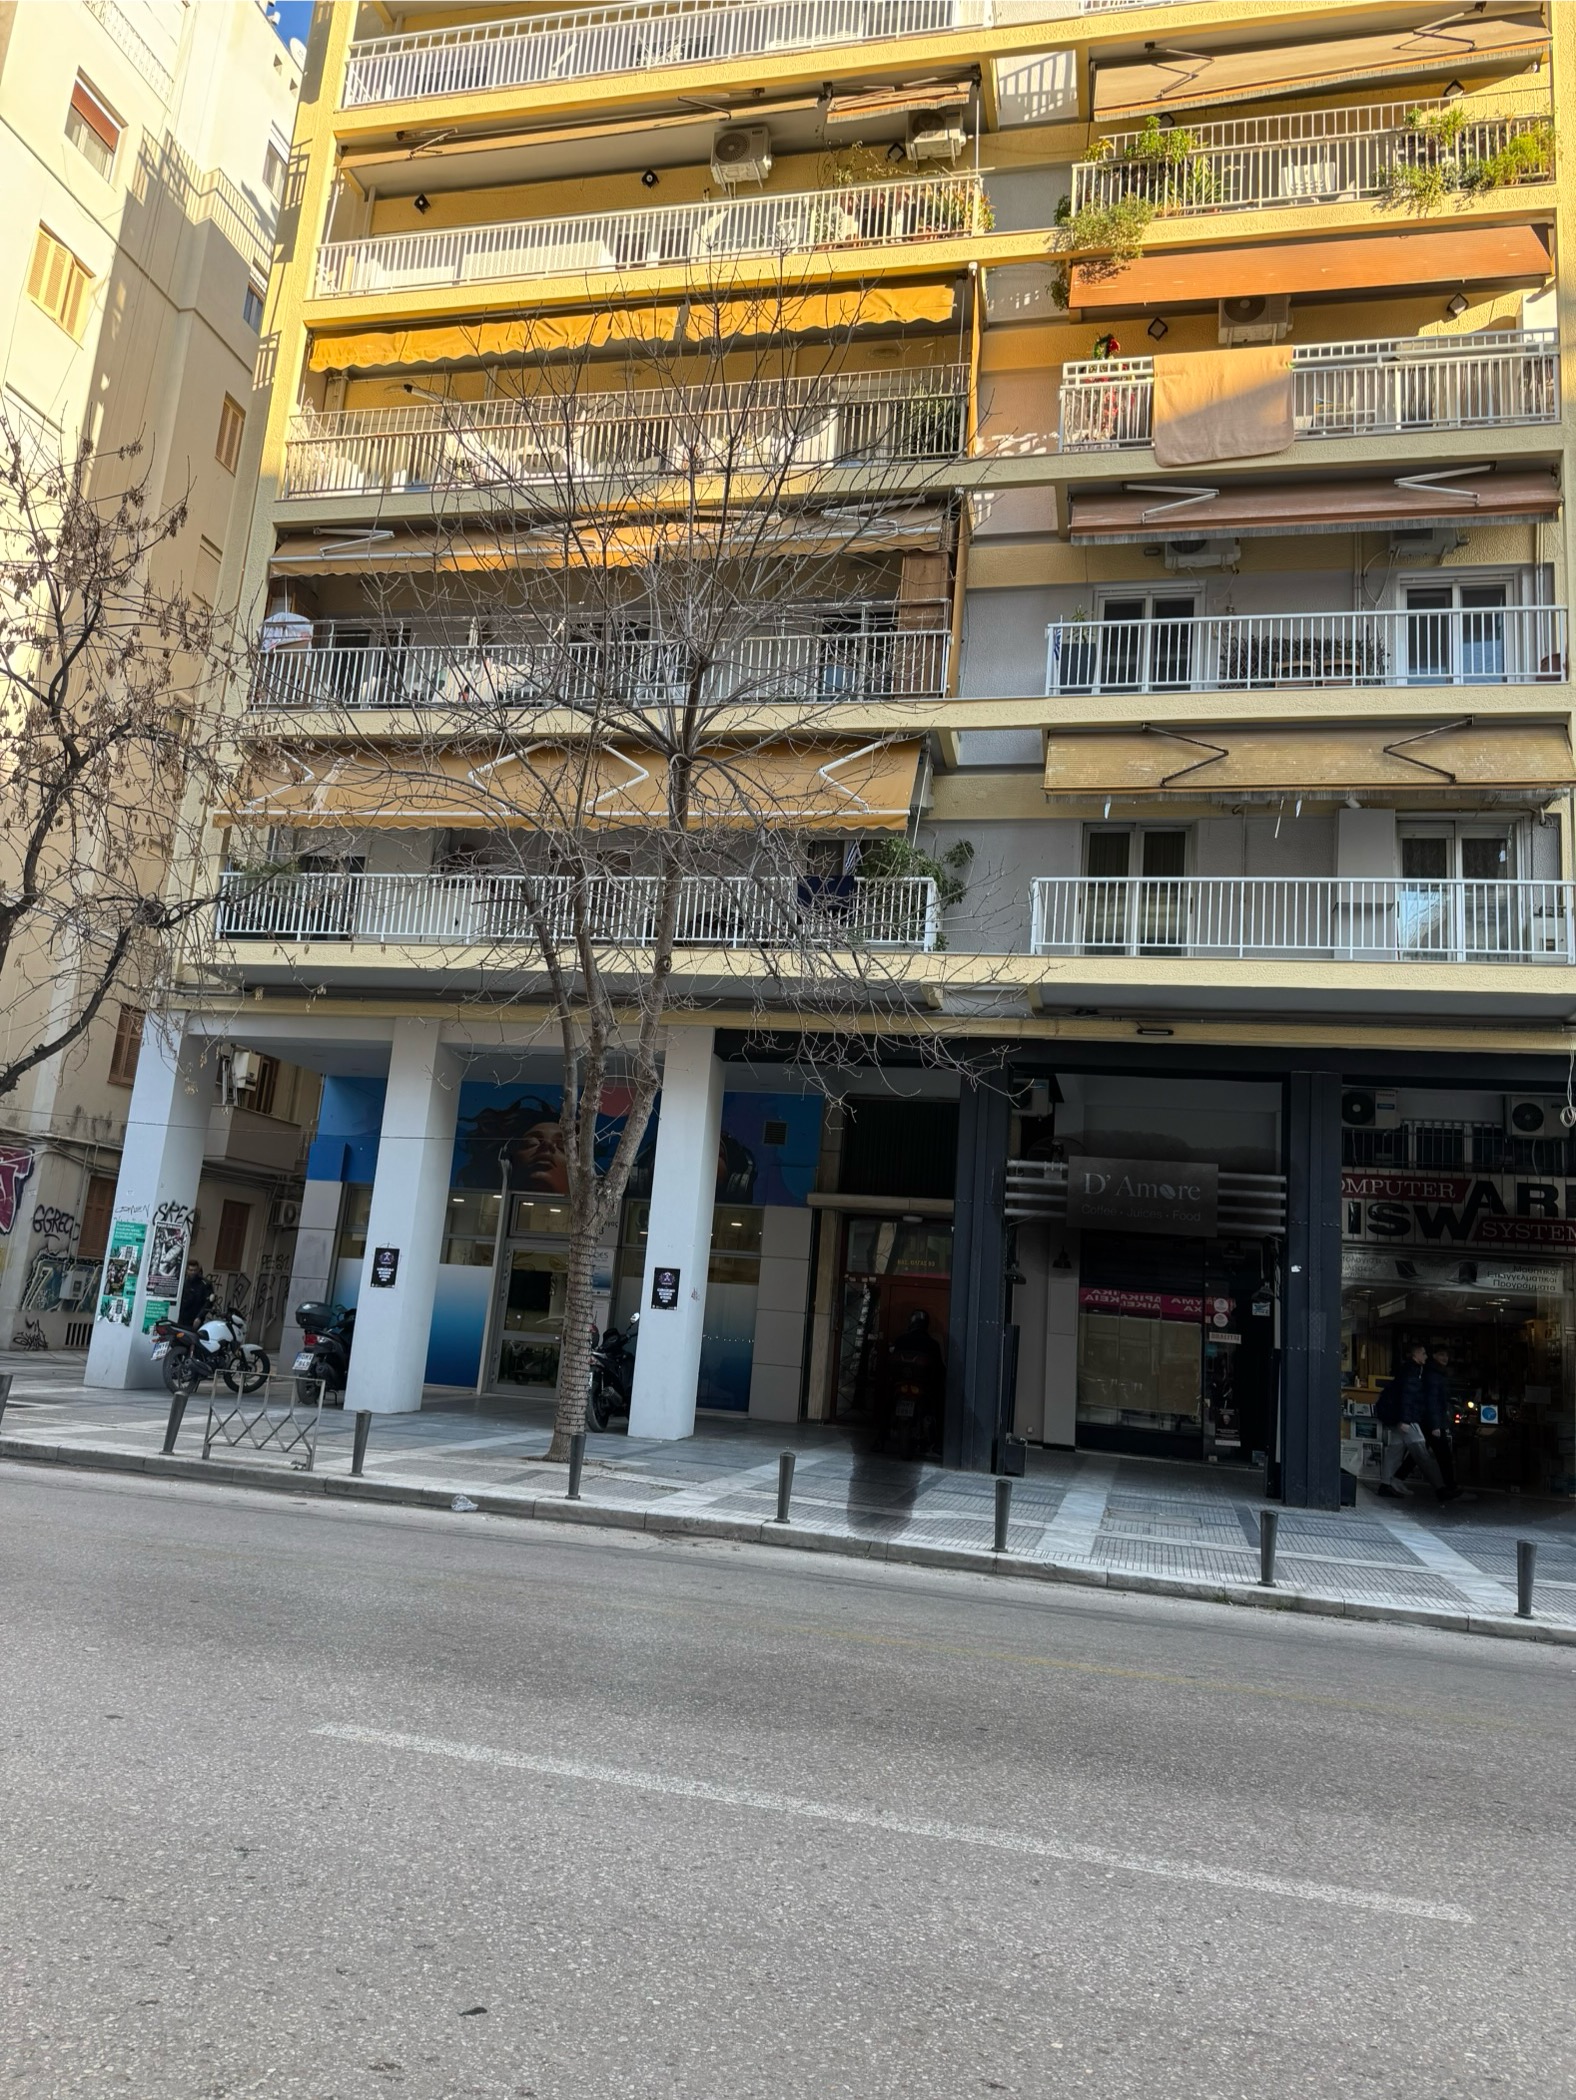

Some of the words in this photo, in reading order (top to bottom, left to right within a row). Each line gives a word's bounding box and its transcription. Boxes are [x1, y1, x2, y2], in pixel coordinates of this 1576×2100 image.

[1081, 1203, 1117, 1217] Coffee
[1126, 1207, 1162, 1219] Juices
[1173, 1209, 1201, 1222] Food
